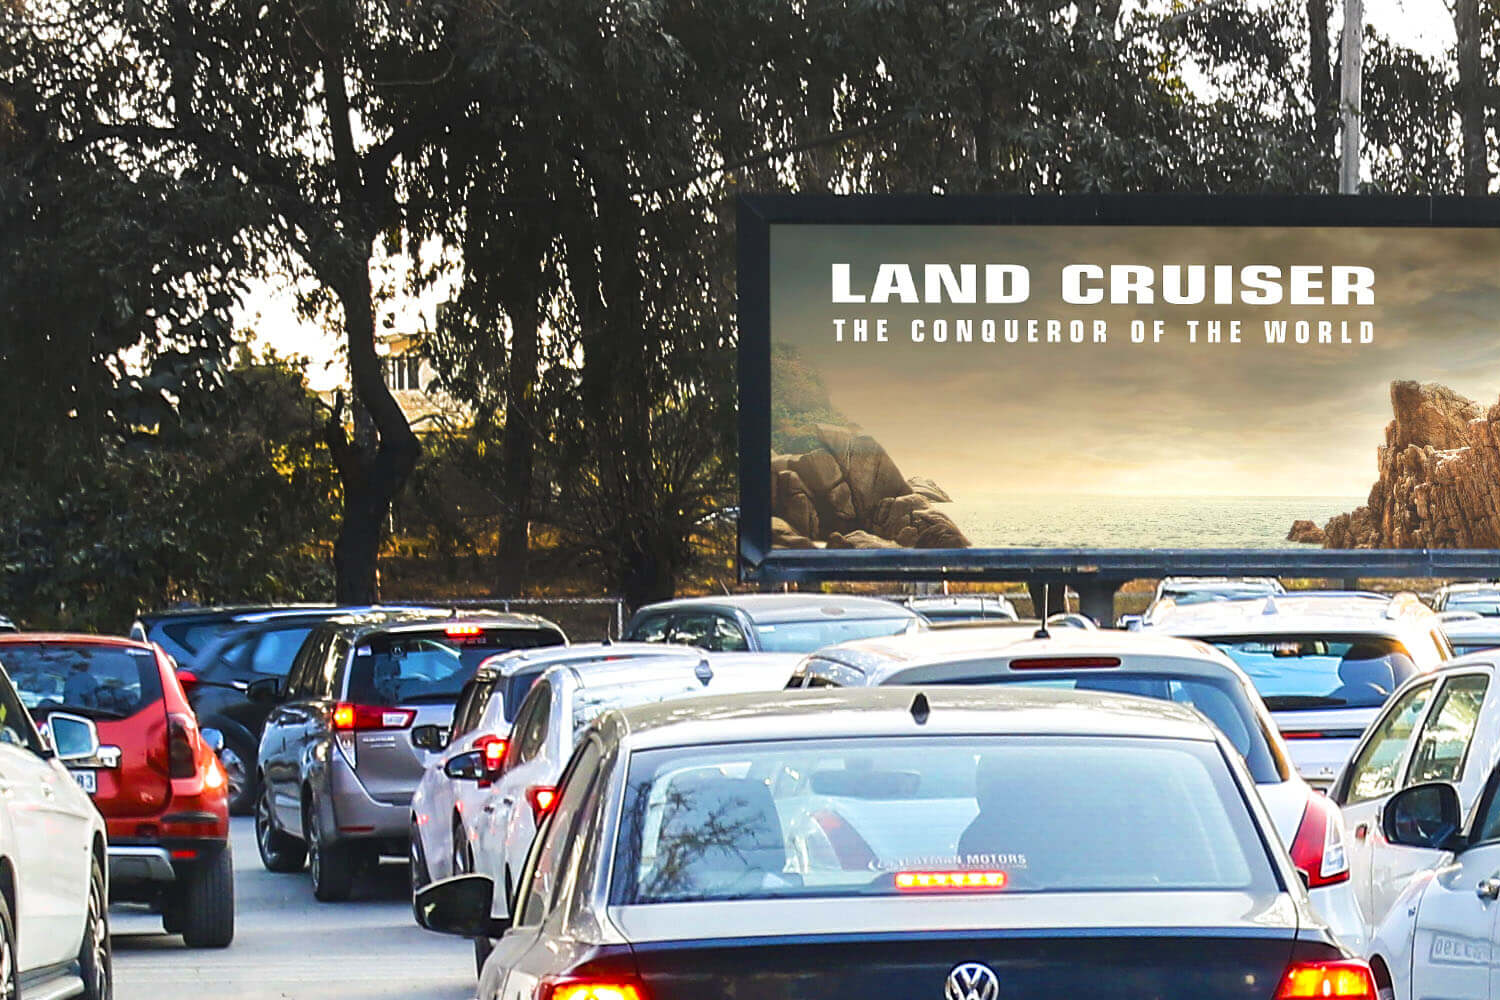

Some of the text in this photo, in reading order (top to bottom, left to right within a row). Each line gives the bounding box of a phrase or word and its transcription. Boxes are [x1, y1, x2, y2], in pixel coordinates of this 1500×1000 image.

[831, 263, 1376, 305] LAND CRUISER
[833, 319, 1375, 343] THE CONQUEROR OF THE WORLD
[966, 853, 1026, 864] MOTORS
